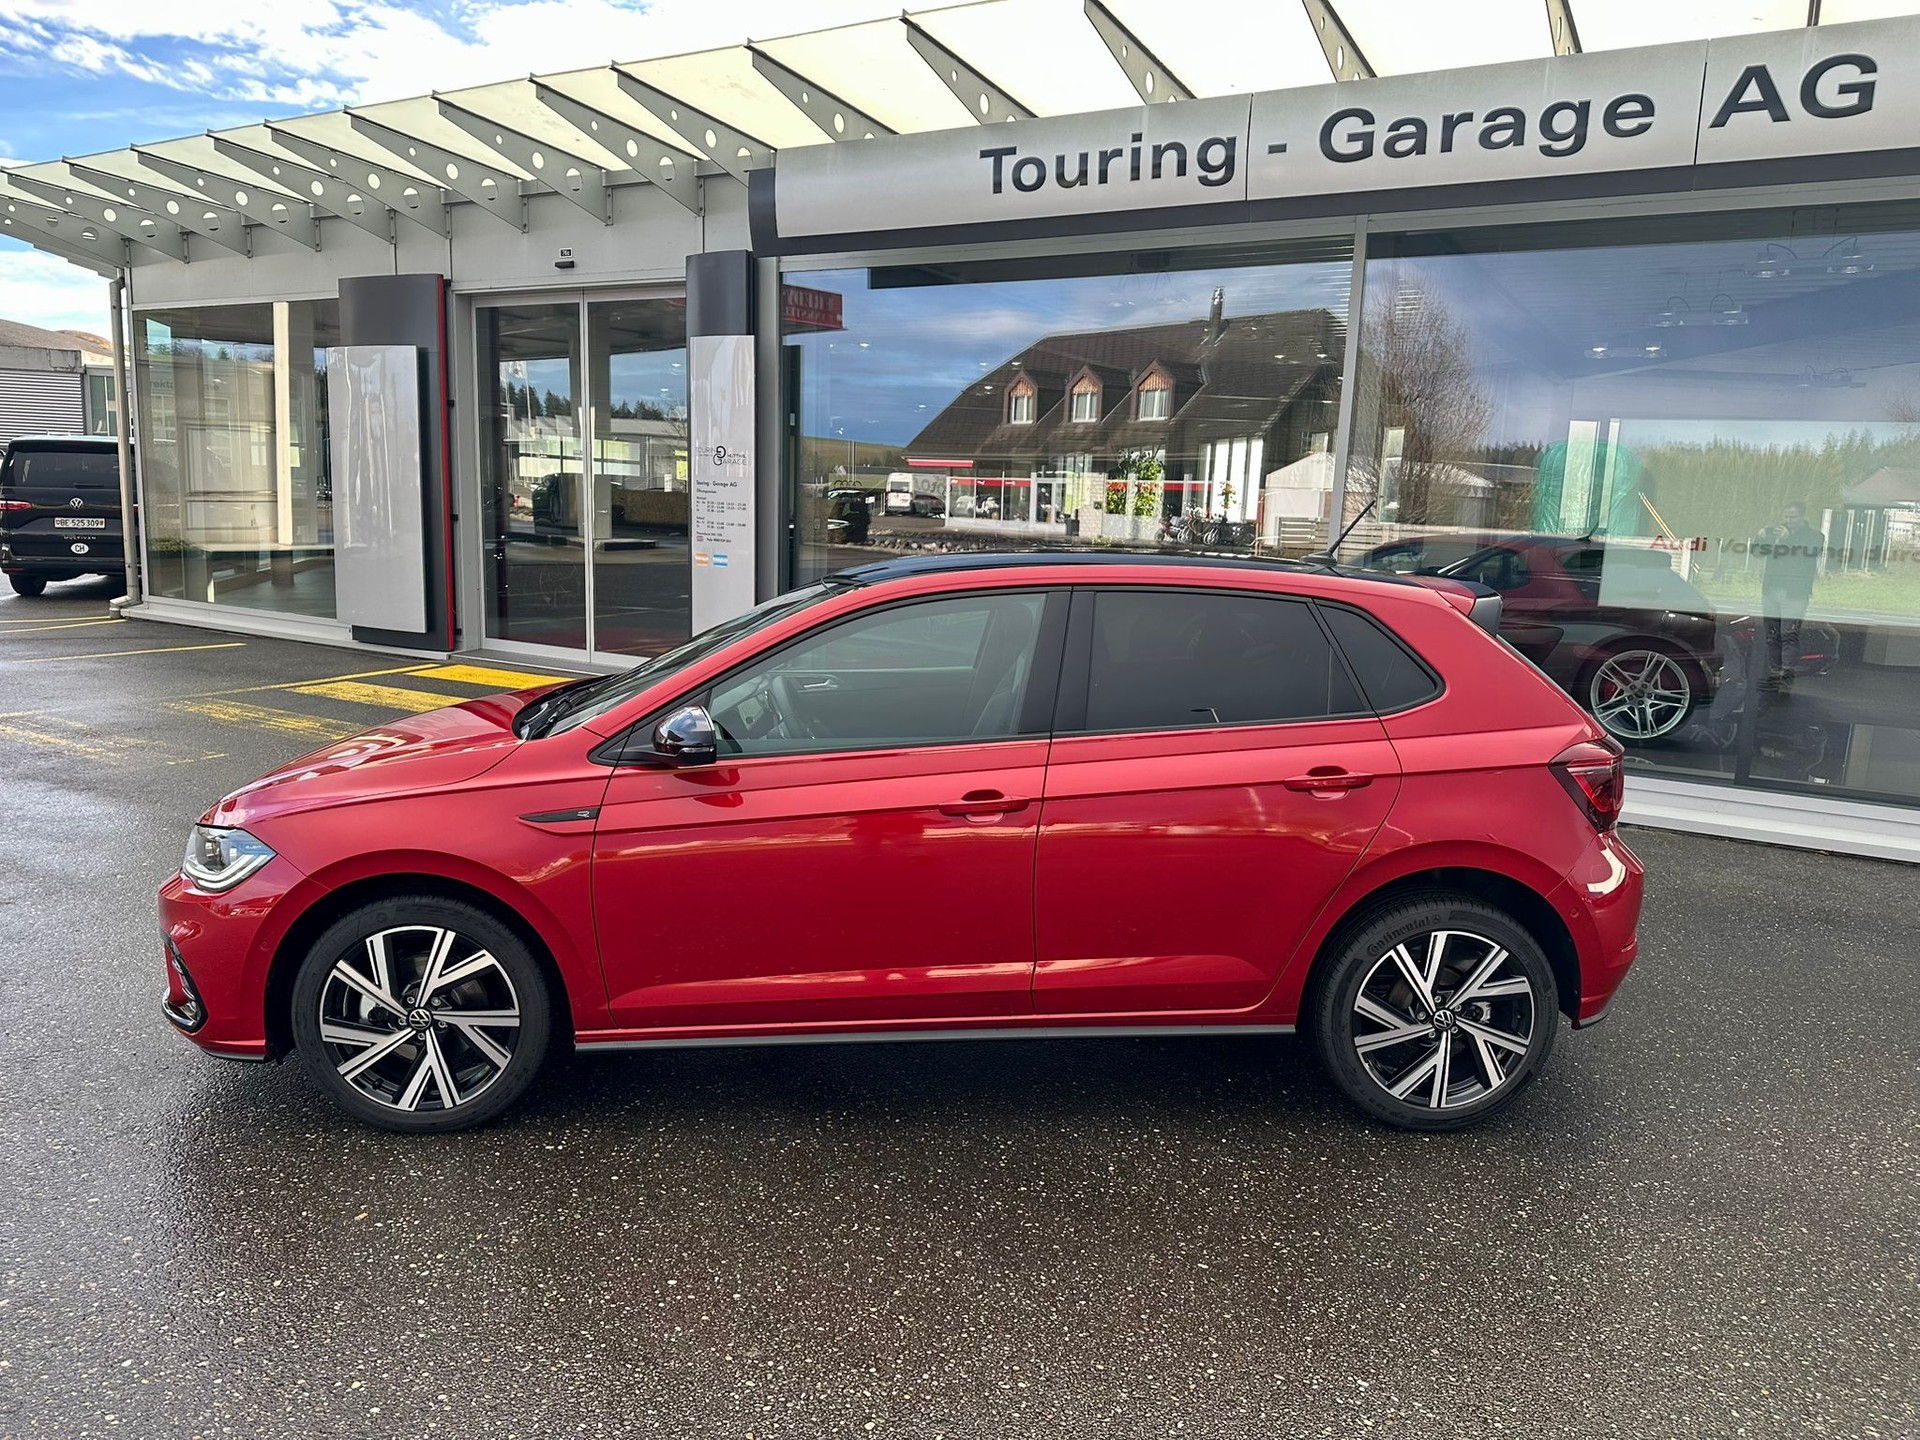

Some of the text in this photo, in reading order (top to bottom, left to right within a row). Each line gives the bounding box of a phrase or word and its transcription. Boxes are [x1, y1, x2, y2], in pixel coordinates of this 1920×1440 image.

[978, 52, 1879, 195] Touring - Garage AG
[74, 544, 85, 553] CH
[1649, 535, 1708, 552] Audi
[1716, 537, 1854, 562] Vorsprung
[1367, 916, 1431, 957] Continental
